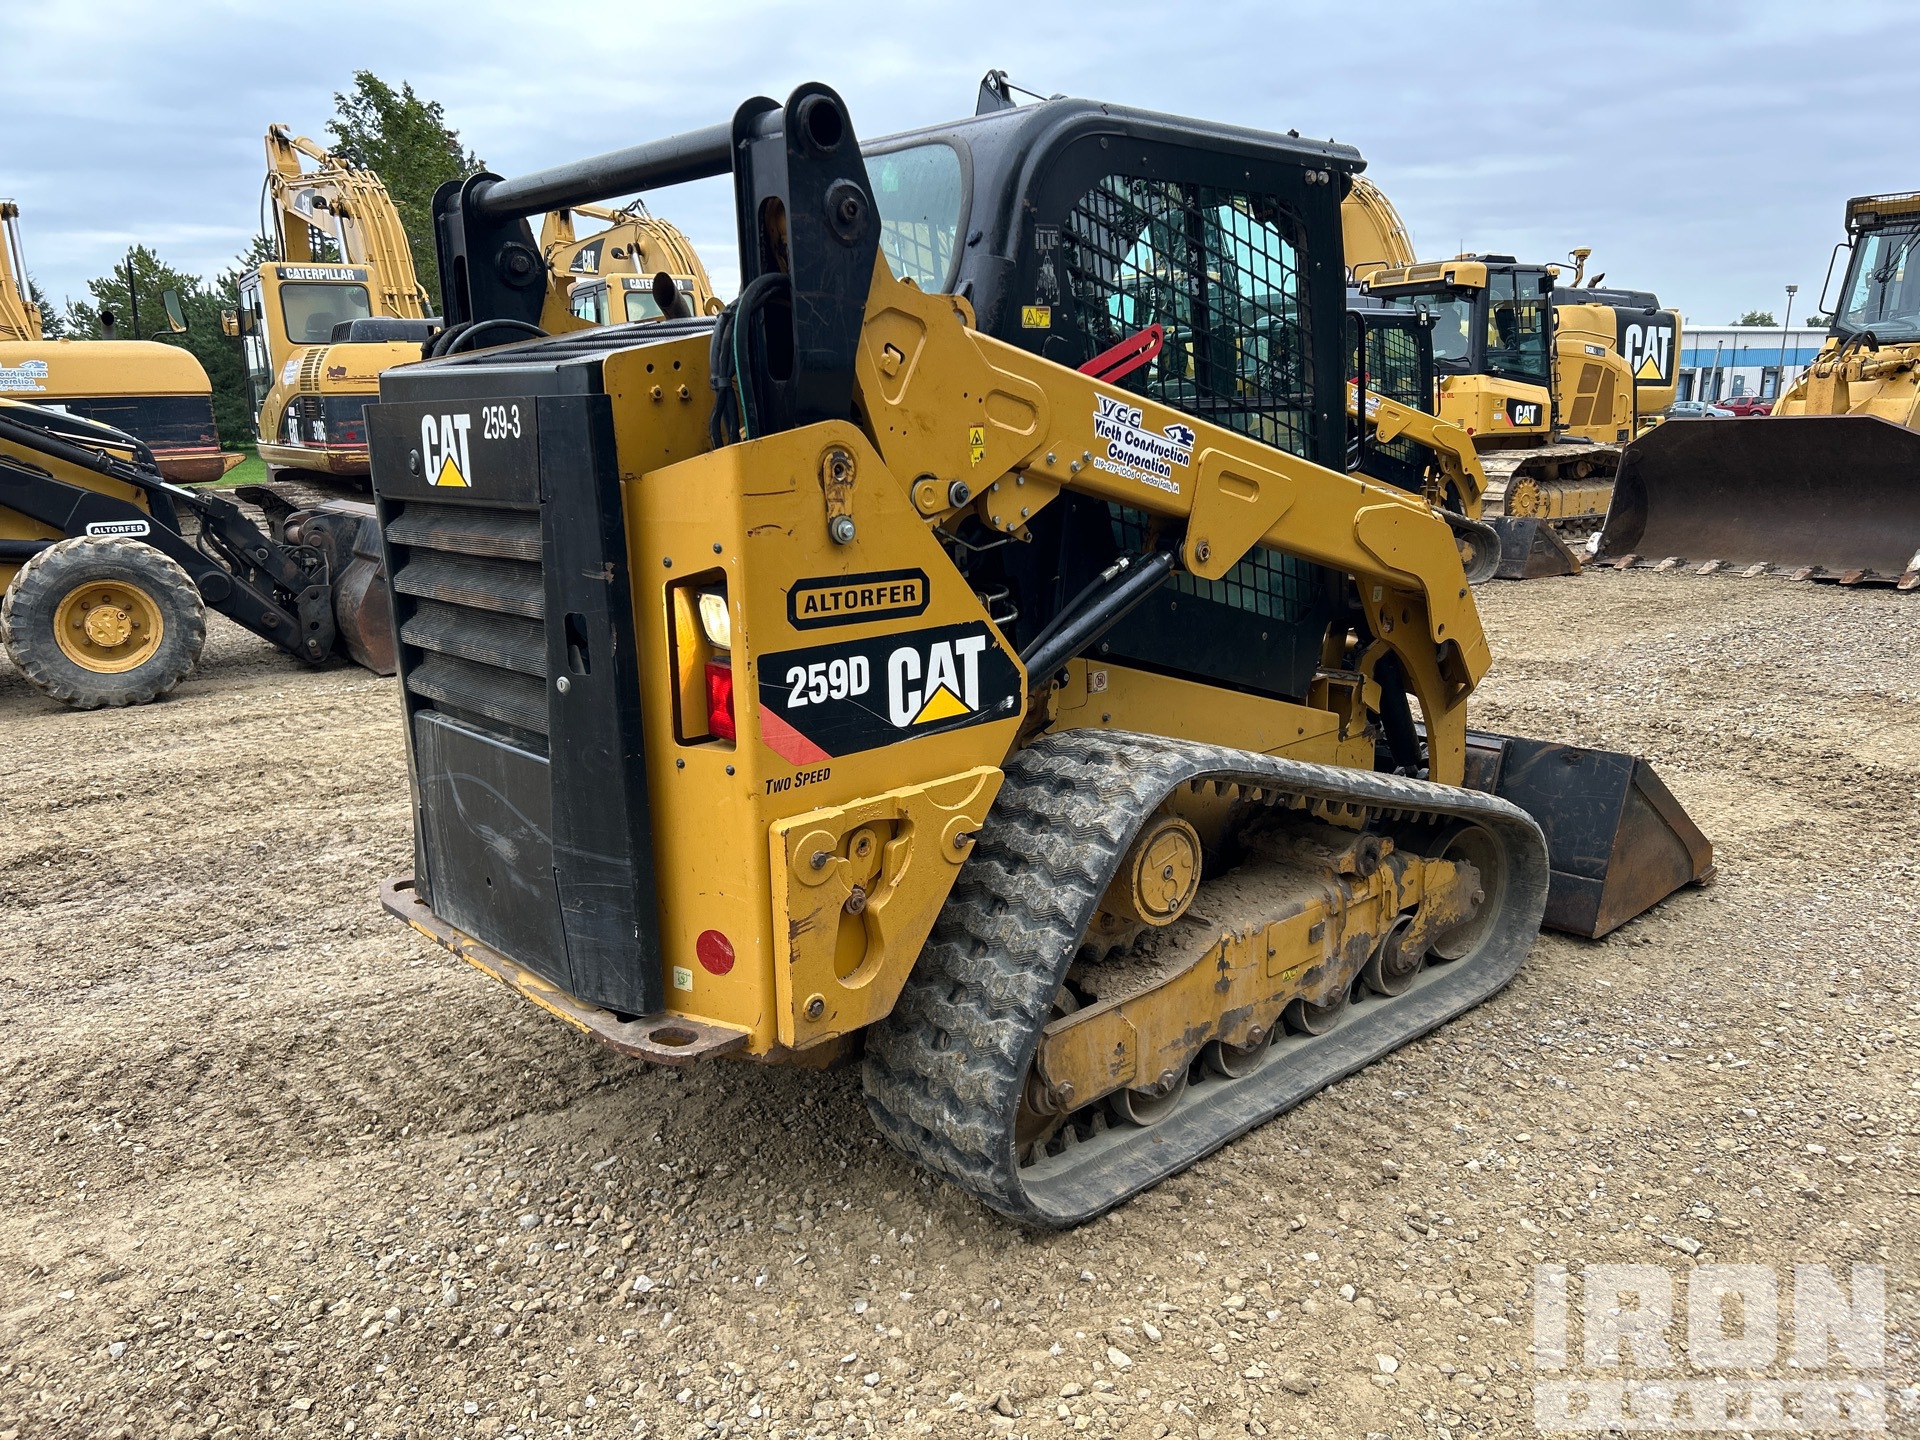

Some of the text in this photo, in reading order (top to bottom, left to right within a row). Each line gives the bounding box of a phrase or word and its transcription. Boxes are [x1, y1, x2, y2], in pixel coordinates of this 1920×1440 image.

[285, 267, 355, 280] CATERPILLAR
[583, 249, 595, 272] CAT
[1624, 323, 1672, 380] CAT
[482, 404, 521, 439] 259-3
[1097, 395, 1142, 429] VCC
[1515, 404, 1537, 425] CAT
[421, 413, 472, 488] CAT
[1095, 418, 1190, 466] Vieth Construction
[1108, 443, 1171, 477] Corporation
[93, 525, 144, 534] ALTORFER
[804, 584, 916, 613] ALTORFER
[786, 635, 986, 728] 259D CAT
